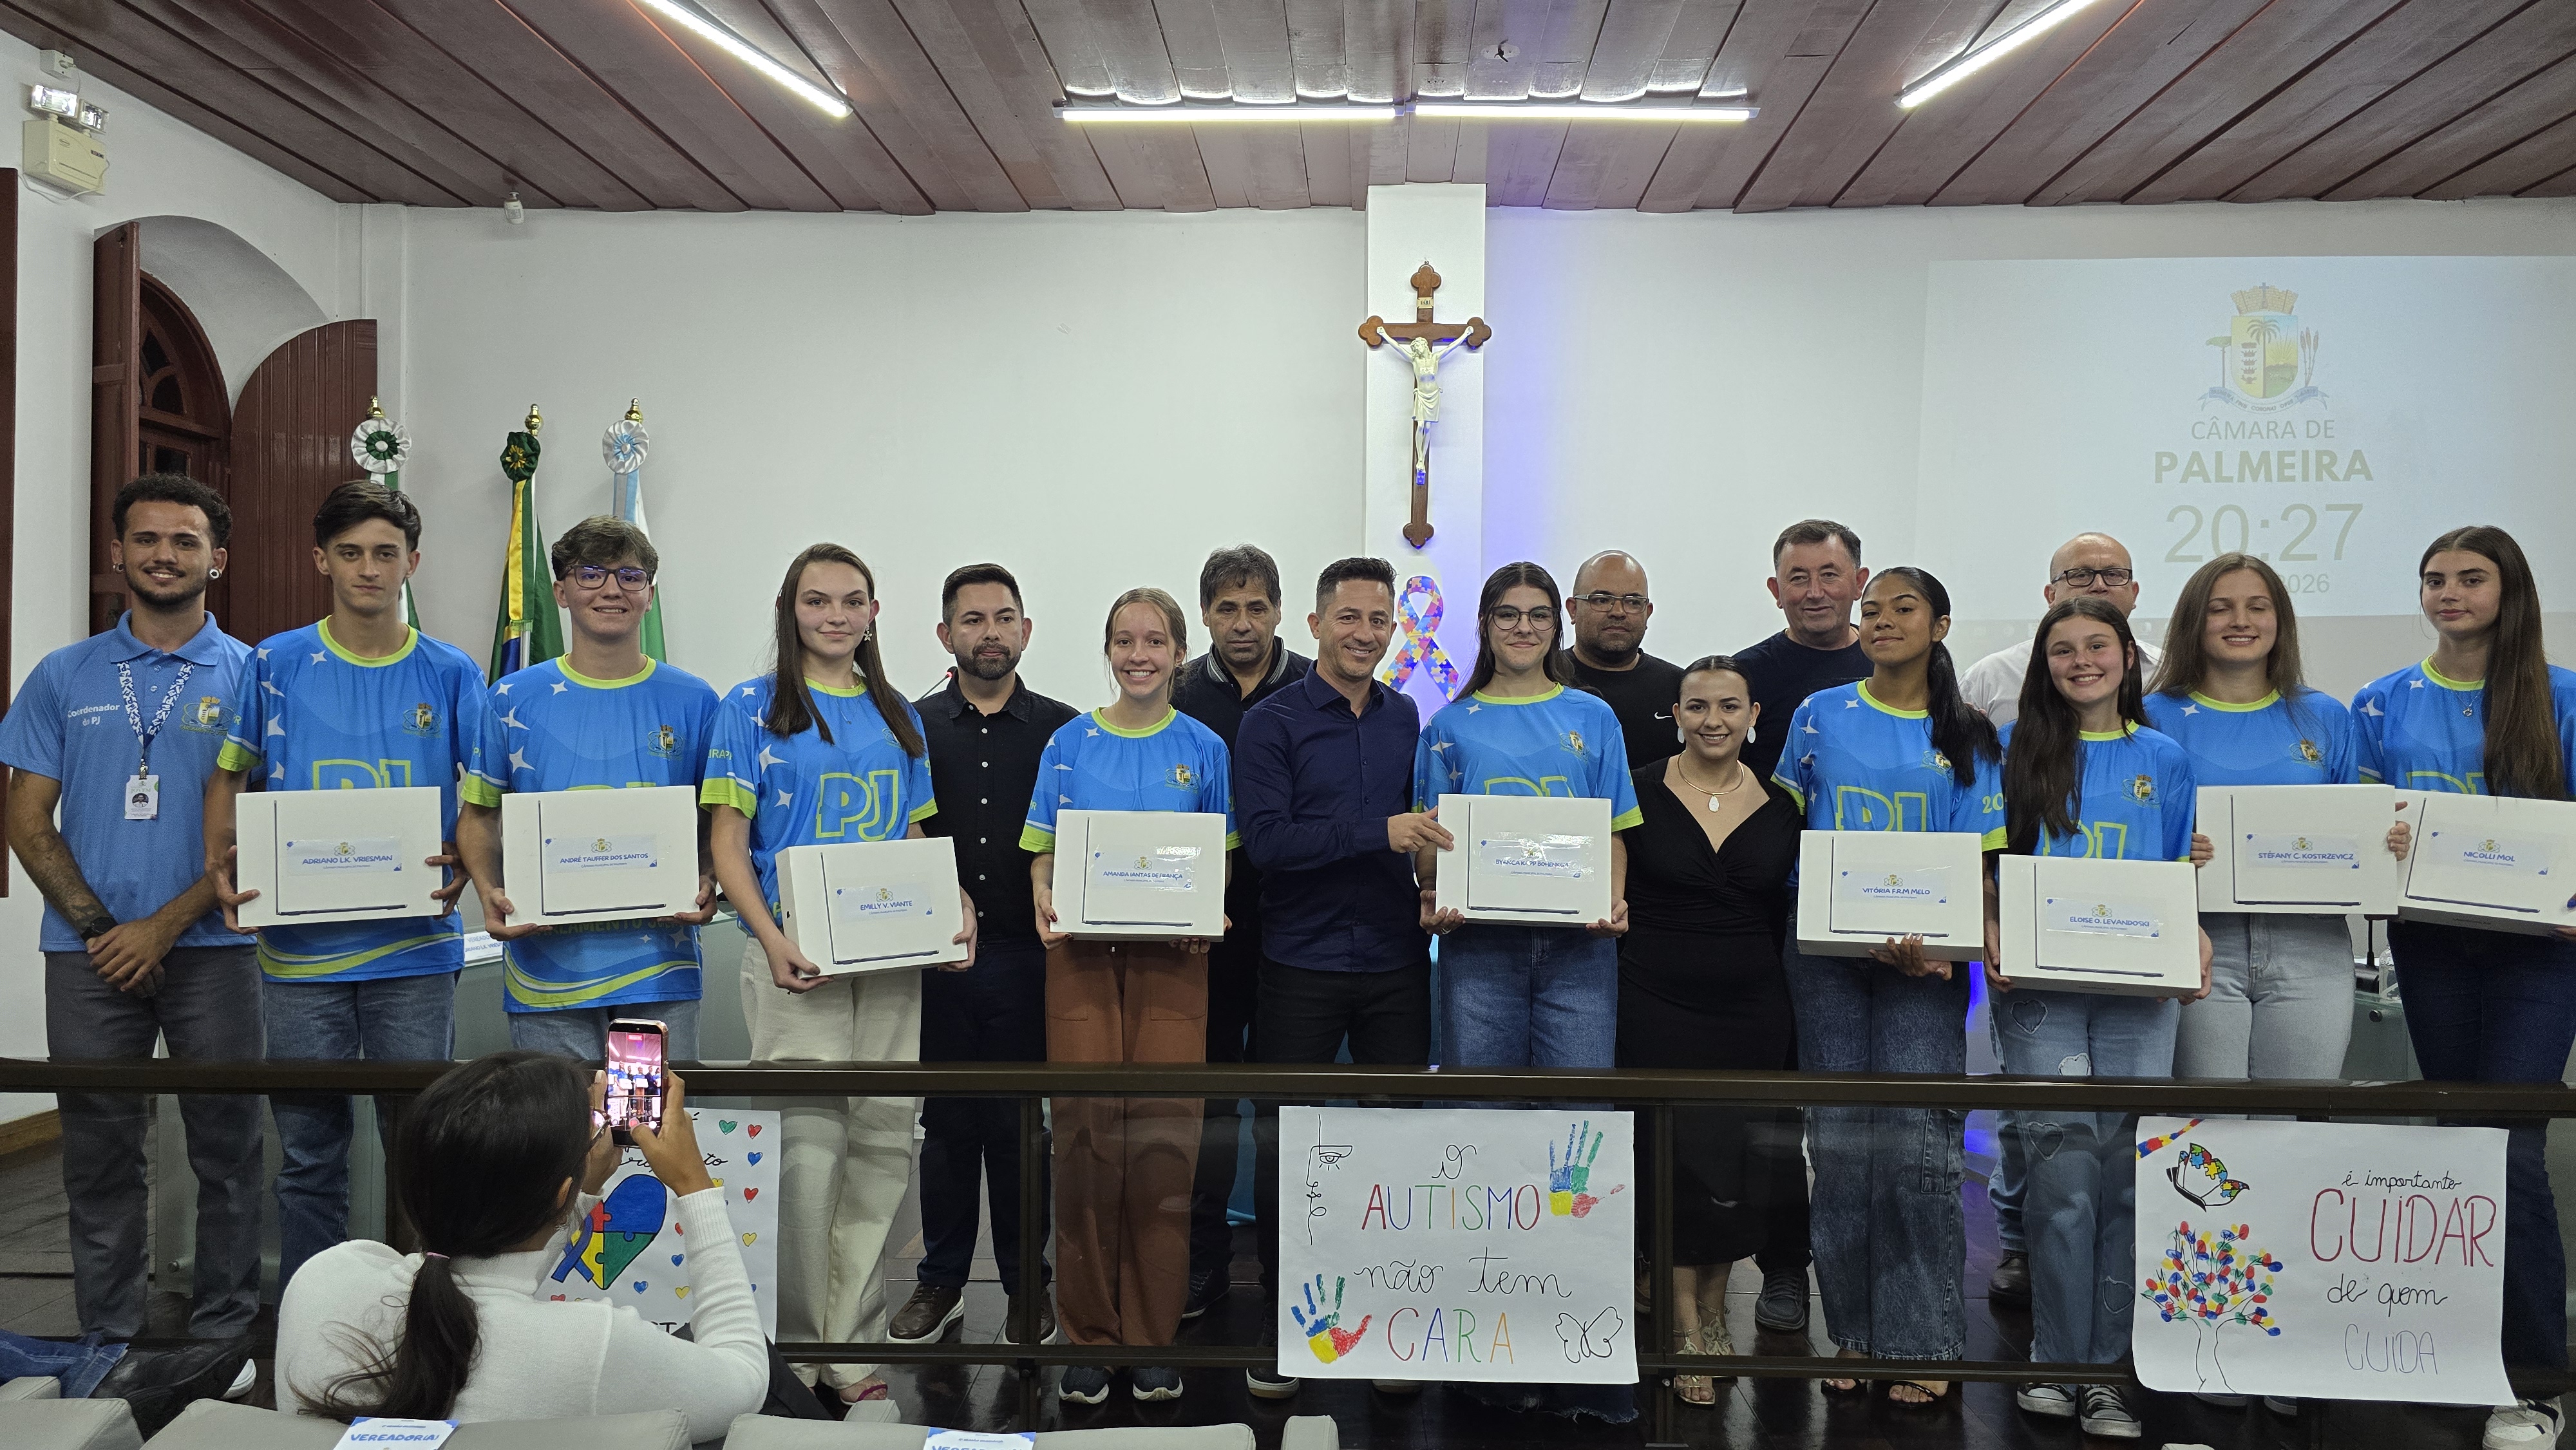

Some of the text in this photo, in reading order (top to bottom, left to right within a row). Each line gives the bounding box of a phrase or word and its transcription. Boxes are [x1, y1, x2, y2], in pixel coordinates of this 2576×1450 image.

[2191, 415, 2335, 440] CÂMARA DE
[2154, 449, 2374, 484] PALMEIRA
[2164, 503, 2363, 563] 20:27
[2281, 574, 2330, 593] 026
[68, 703, 120, 718] Coordenador
[91, 716, 100, 726] PJ
[815, 769, 899, 842] PJ
[560, 855, 582, 863] ANDRÉ
[2258, 851, 2291, 859] STÉFANY
[2463, 851, 2515, 862] NICOLLI MOL
[2364, 1170, 2462, 1192] importante
[1361, 1183, 1540, 1230] AUTISMO
[1354, 1247, 1572, 1298] não tem
[2327, 1274, 2448, 1317] de quem
[1387, 1307, 1513, 1364] CARA
[350, 1433, 440, 1442] VEREADOR(A)
